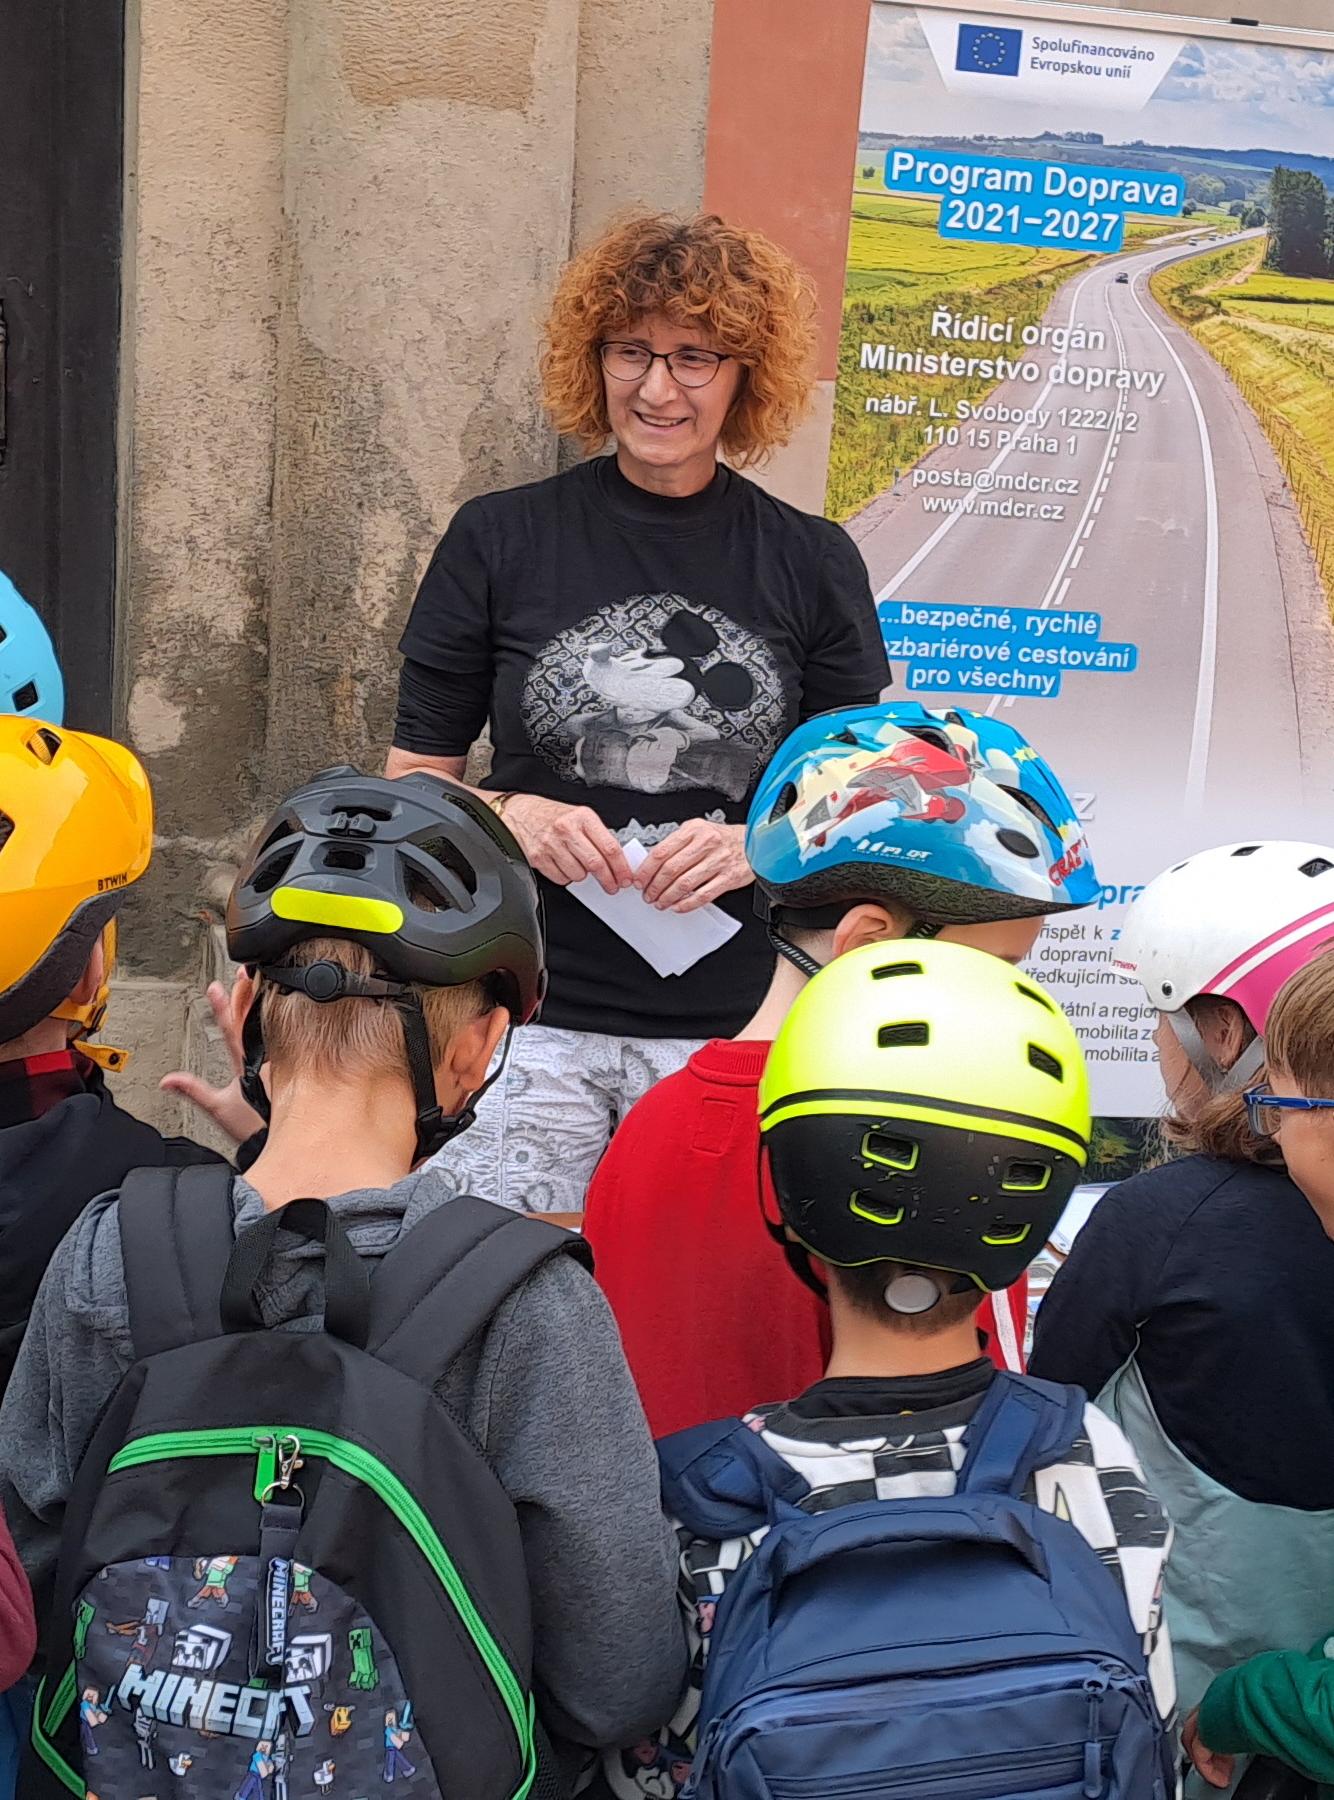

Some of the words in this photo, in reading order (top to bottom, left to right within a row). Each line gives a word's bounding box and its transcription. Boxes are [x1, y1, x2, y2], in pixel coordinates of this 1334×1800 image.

[1032, 36, 1155, 61] Spolufinancováno
[1030, 57, 1101, 75] Evropskou
[1105, 65, 1132, 79] unií
[891, 151, 1033, 195] Program
[1043, 166, 1178, 207] Doprava
[930, 304, 1015, 343] Řídicí
[1021, 322, 1105, 354] orgán
[860, 342, 1039, 382] Ministerstvo
[1048, 359, 1165, 397] dopravy
[865, 395, 922, 416] nábř.
[929, 398, 948, 418] L.
[955, 400, 1050, 429] Svobody
[1057, 407, 1139, 432] 1222/12
[923, 425, 959, 447] 110
[967, 428, 991, 448] 15
[997, 430, 1059, 454] Praha
[1067, 435, 1077, 455] 1
[912, 467, 1080, 494] posta@mdcr.cz
[922, 496, 1065, 520] www.mdcr.cz
[1026, 613, 1098, 636] rychlé
[884, 636, 1011, 662] zbariérové
[1018, 646, 1130, 668] cestování
[912, 668, 951, 688] pro
[958, 666, 1056, 696] všechny
[98, 872, 127, 891] BTWIN
[1039, 923, 1086, 943] řispět
[1093, 925, 1103, 940] k
[1098, 1006, 1109, 1017] a
[1075, 1024, 1138, 1040] mobilita
[1085, 1046, 1147, 1062] mobilita
